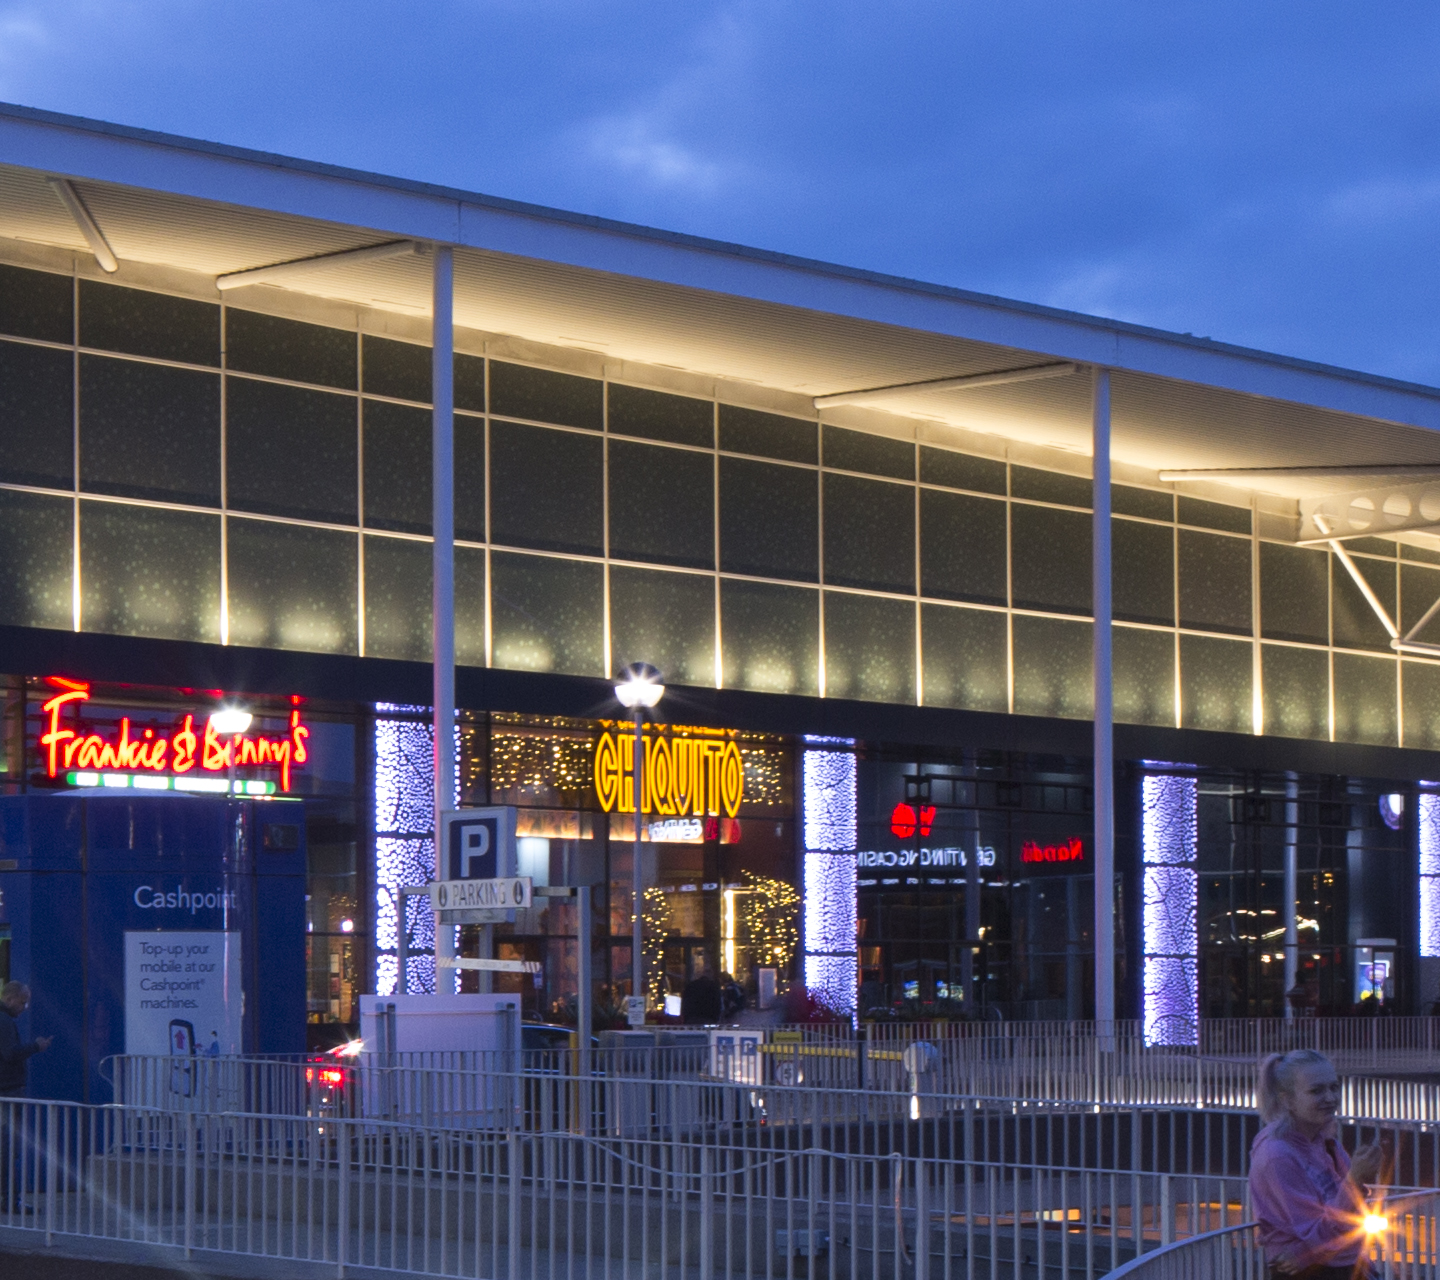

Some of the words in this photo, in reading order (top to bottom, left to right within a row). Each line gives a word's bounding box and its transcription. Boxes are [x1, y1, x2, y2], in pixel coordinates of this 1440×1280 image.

[41, 690, 168, 778] Frankie
[594, 732, 744, 818] CHIQUITO
[460, 825, 490, 878] P
[133, 885, 237, 915] Cashpoint
[452, 882, 506, 907] PARKING
[139, 942, 183, 957] Top-up
[186, 943, 209, 957] your
[140, 959, 183, 973] mobile
[188, 962, 199, 973] at
[201, 963, 216, 973] our
[140, 996, 199, 1010] machines.
